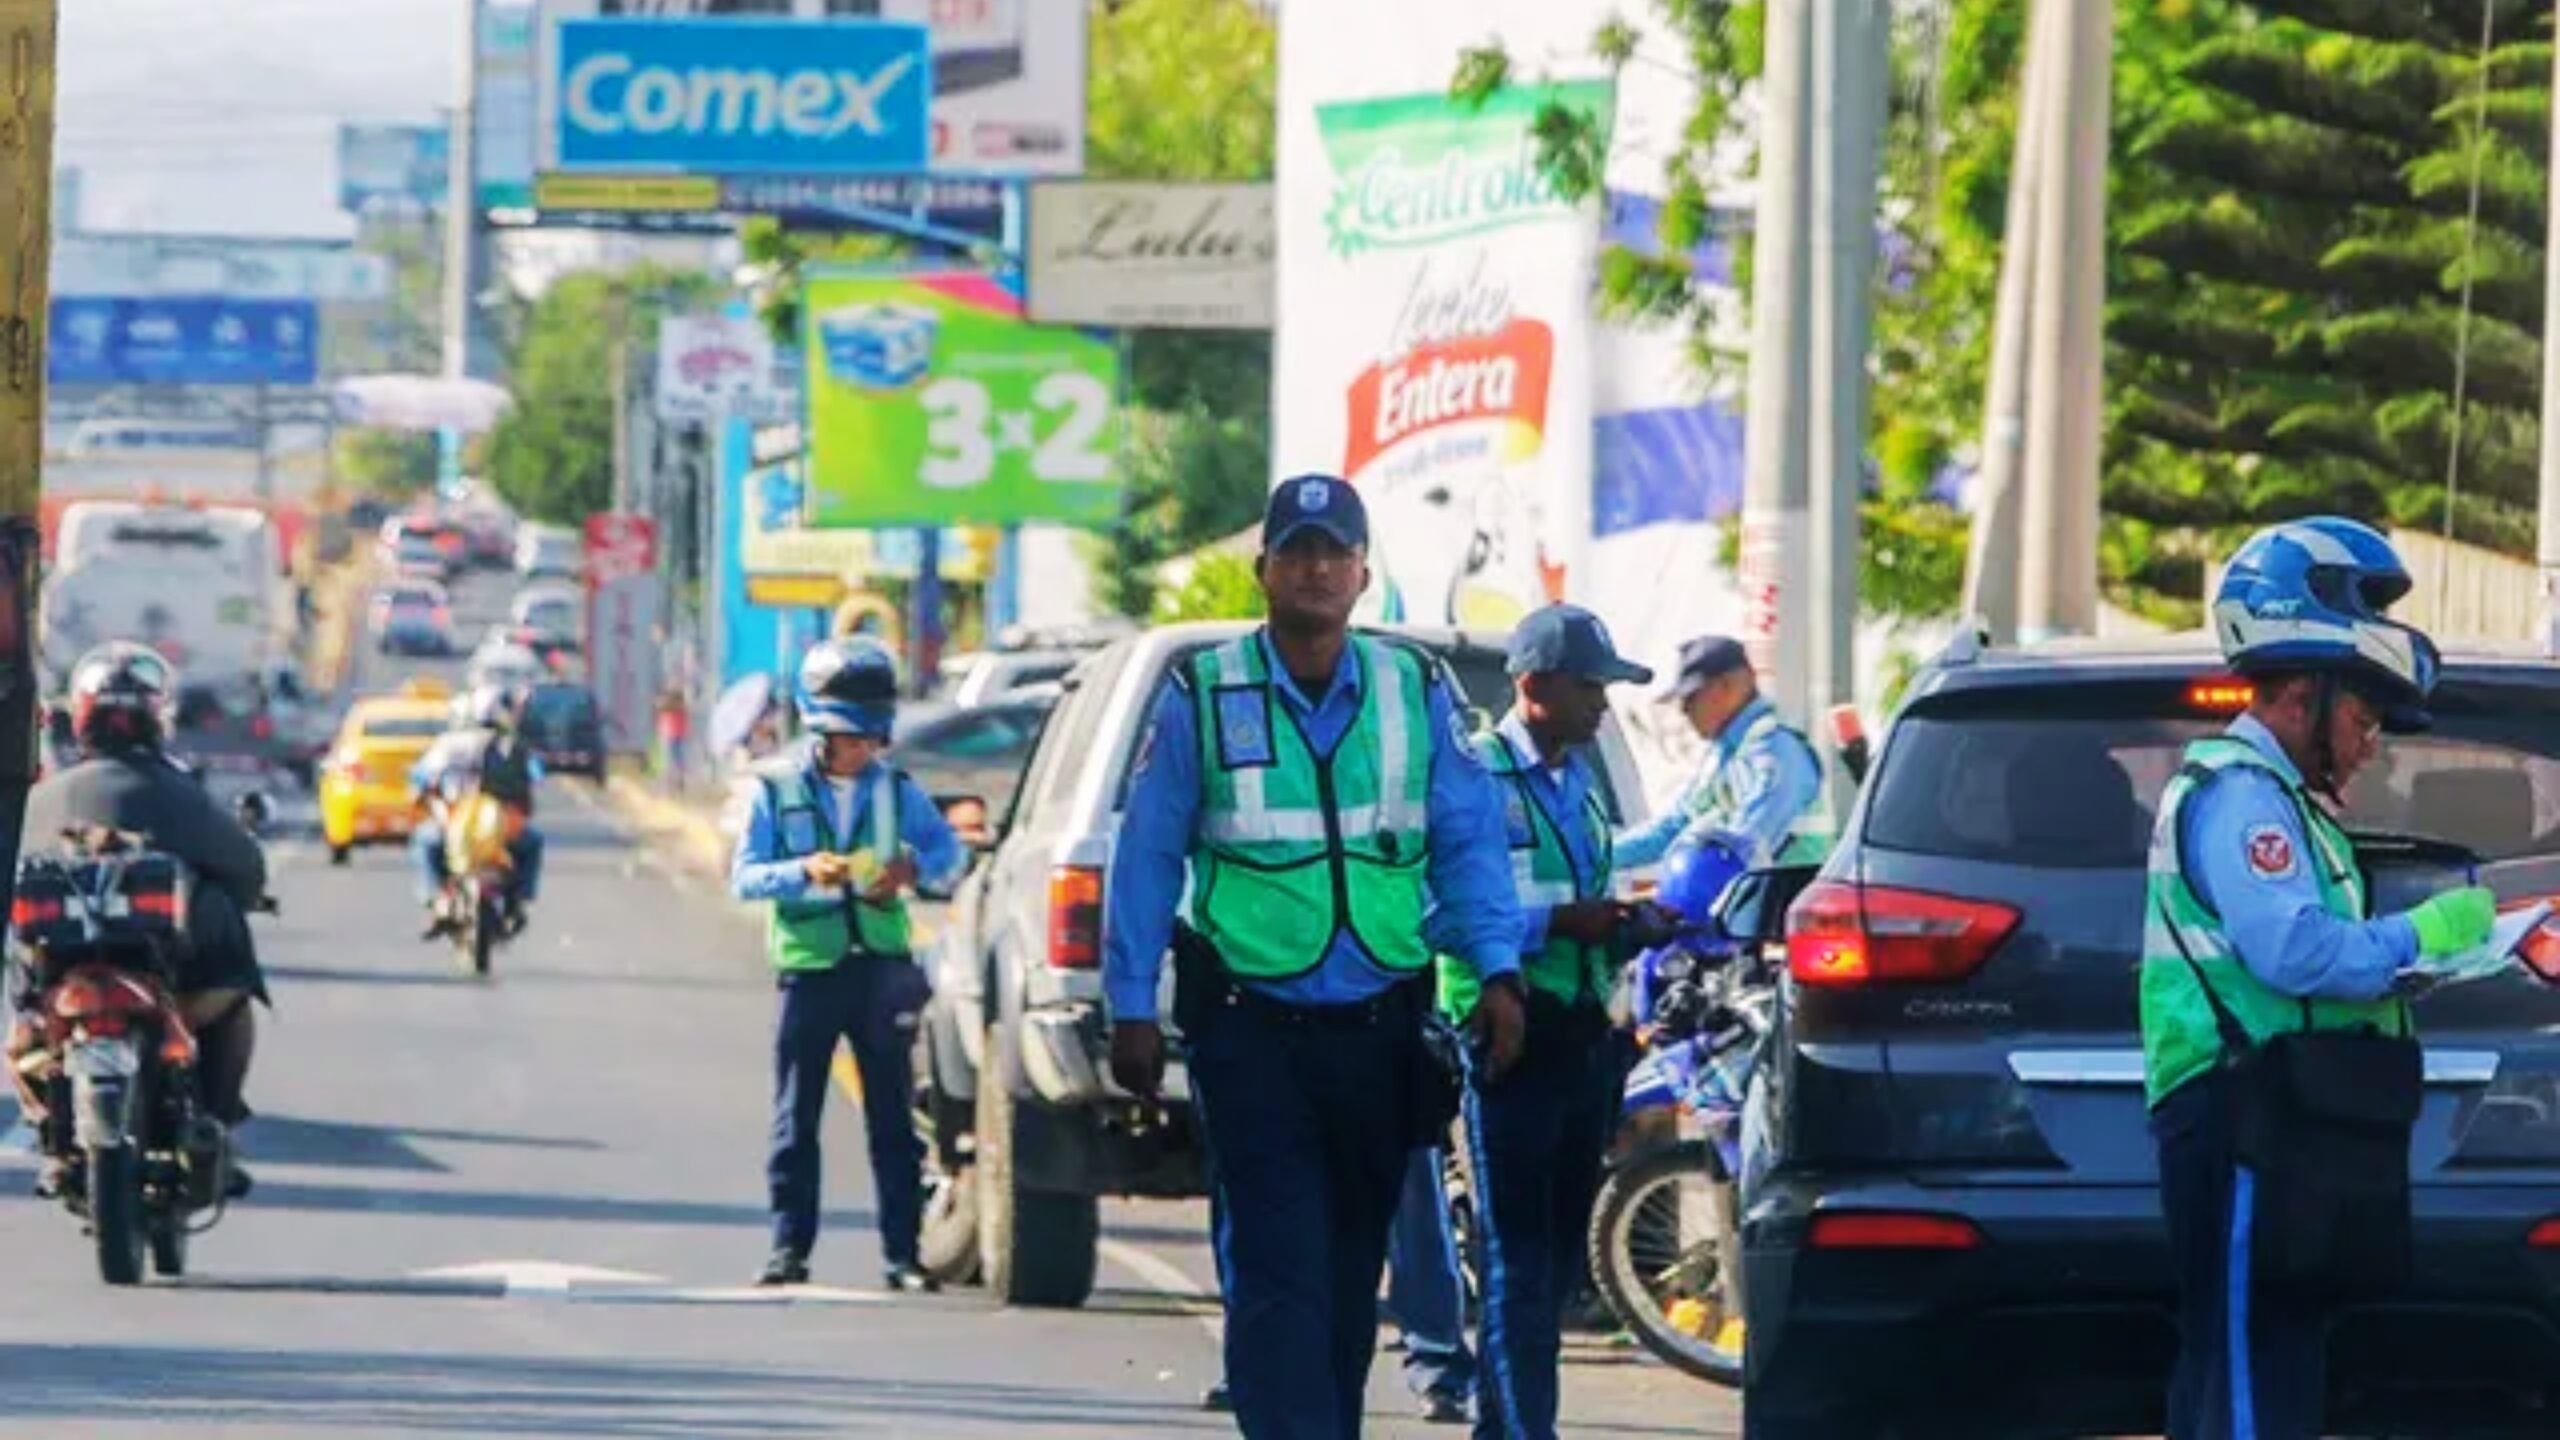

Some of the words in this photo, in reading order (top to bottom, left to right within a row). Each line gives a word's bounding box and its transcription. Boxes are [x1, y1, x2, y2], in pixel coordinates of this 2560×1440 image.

[566, 52, 914, 137] Comex
[1358, 134, 1574, 230] Centrola
[1374, 354, 1516, 444] Entera
